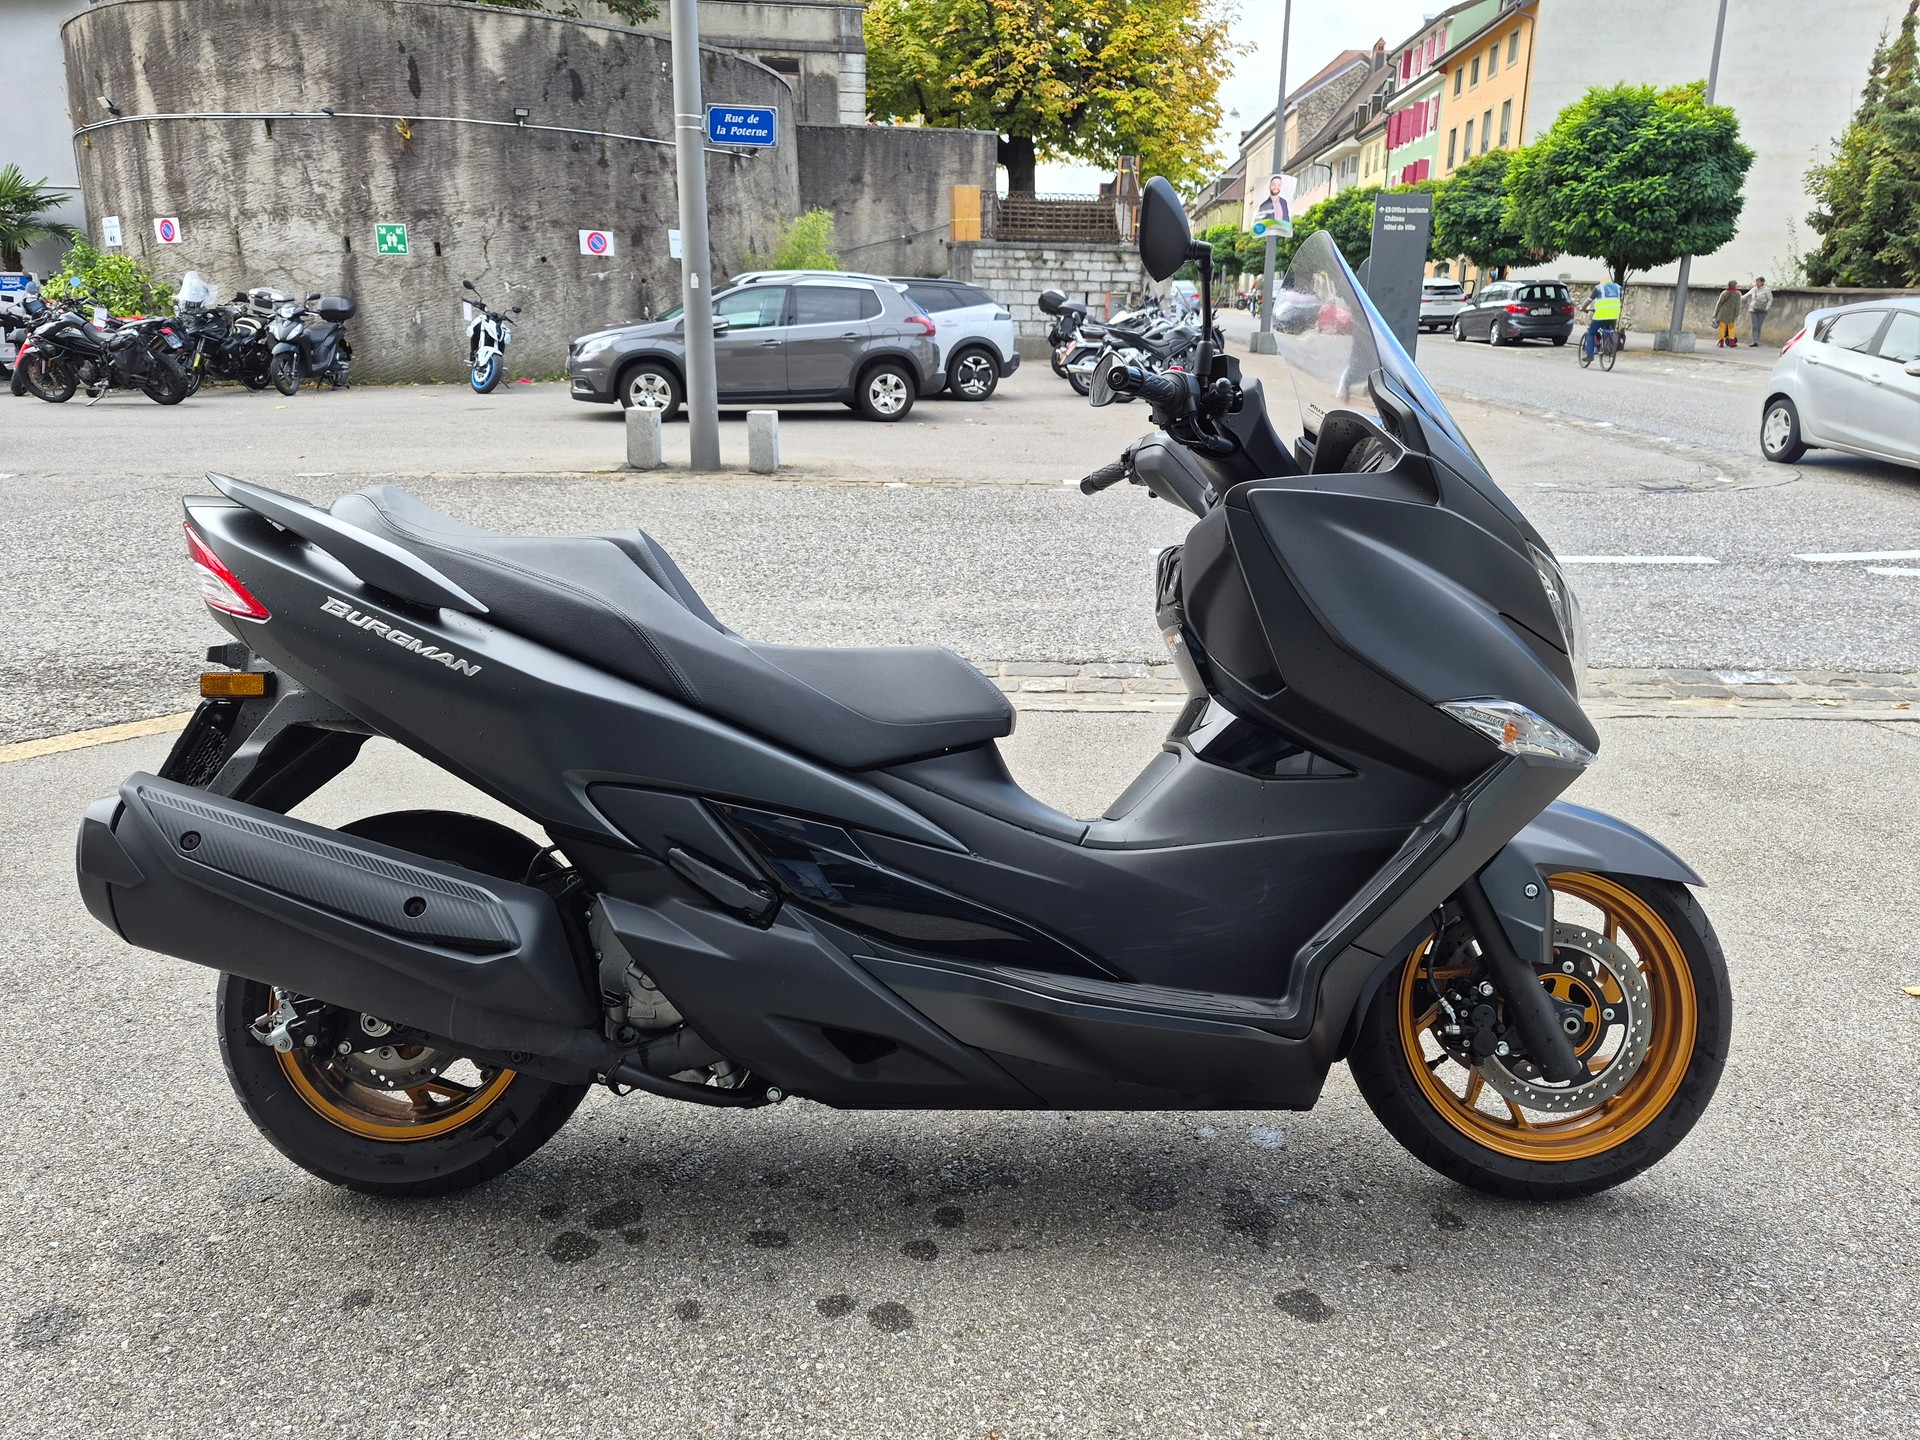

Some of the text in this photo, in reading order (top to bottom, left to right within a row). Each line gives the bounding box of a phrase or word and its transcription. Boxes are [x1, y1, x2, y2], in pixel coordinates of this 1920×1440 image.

[724, 113, 759, 124] Rue de
[716, 125, 768, 137] la Poterne
[320, 595, 482, 677] BURGMAN
